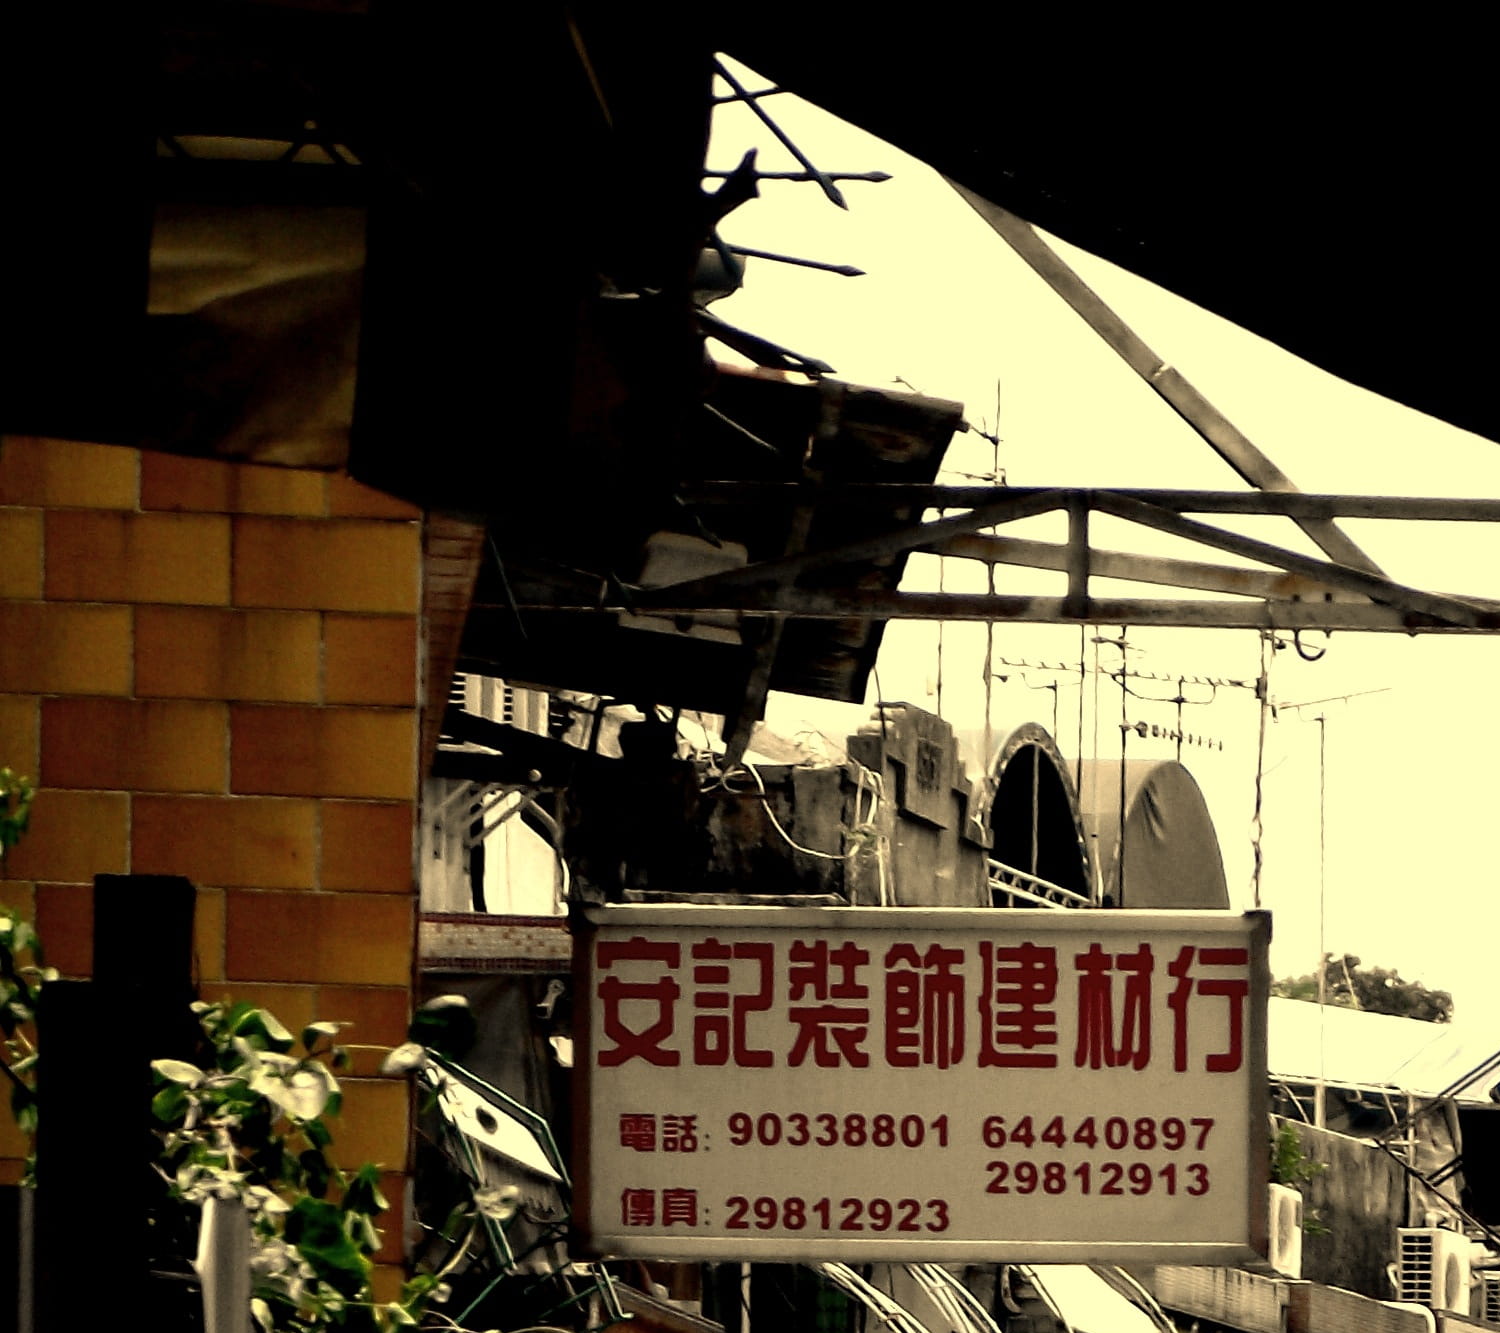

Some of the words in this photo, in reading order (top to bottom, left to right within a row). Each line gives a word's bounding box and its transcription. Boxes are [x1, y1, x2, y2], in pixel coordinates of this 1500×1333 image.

[598, 937, 1249, 1073] 安記裝飾建材行
[728, 1113, 950, 1149] 90338801
[982, 1116, 1215, 1152] 64440897
[986, 1161, 1211, 1198] 29812913
[725, 1197, 951, 1234] 29812923
